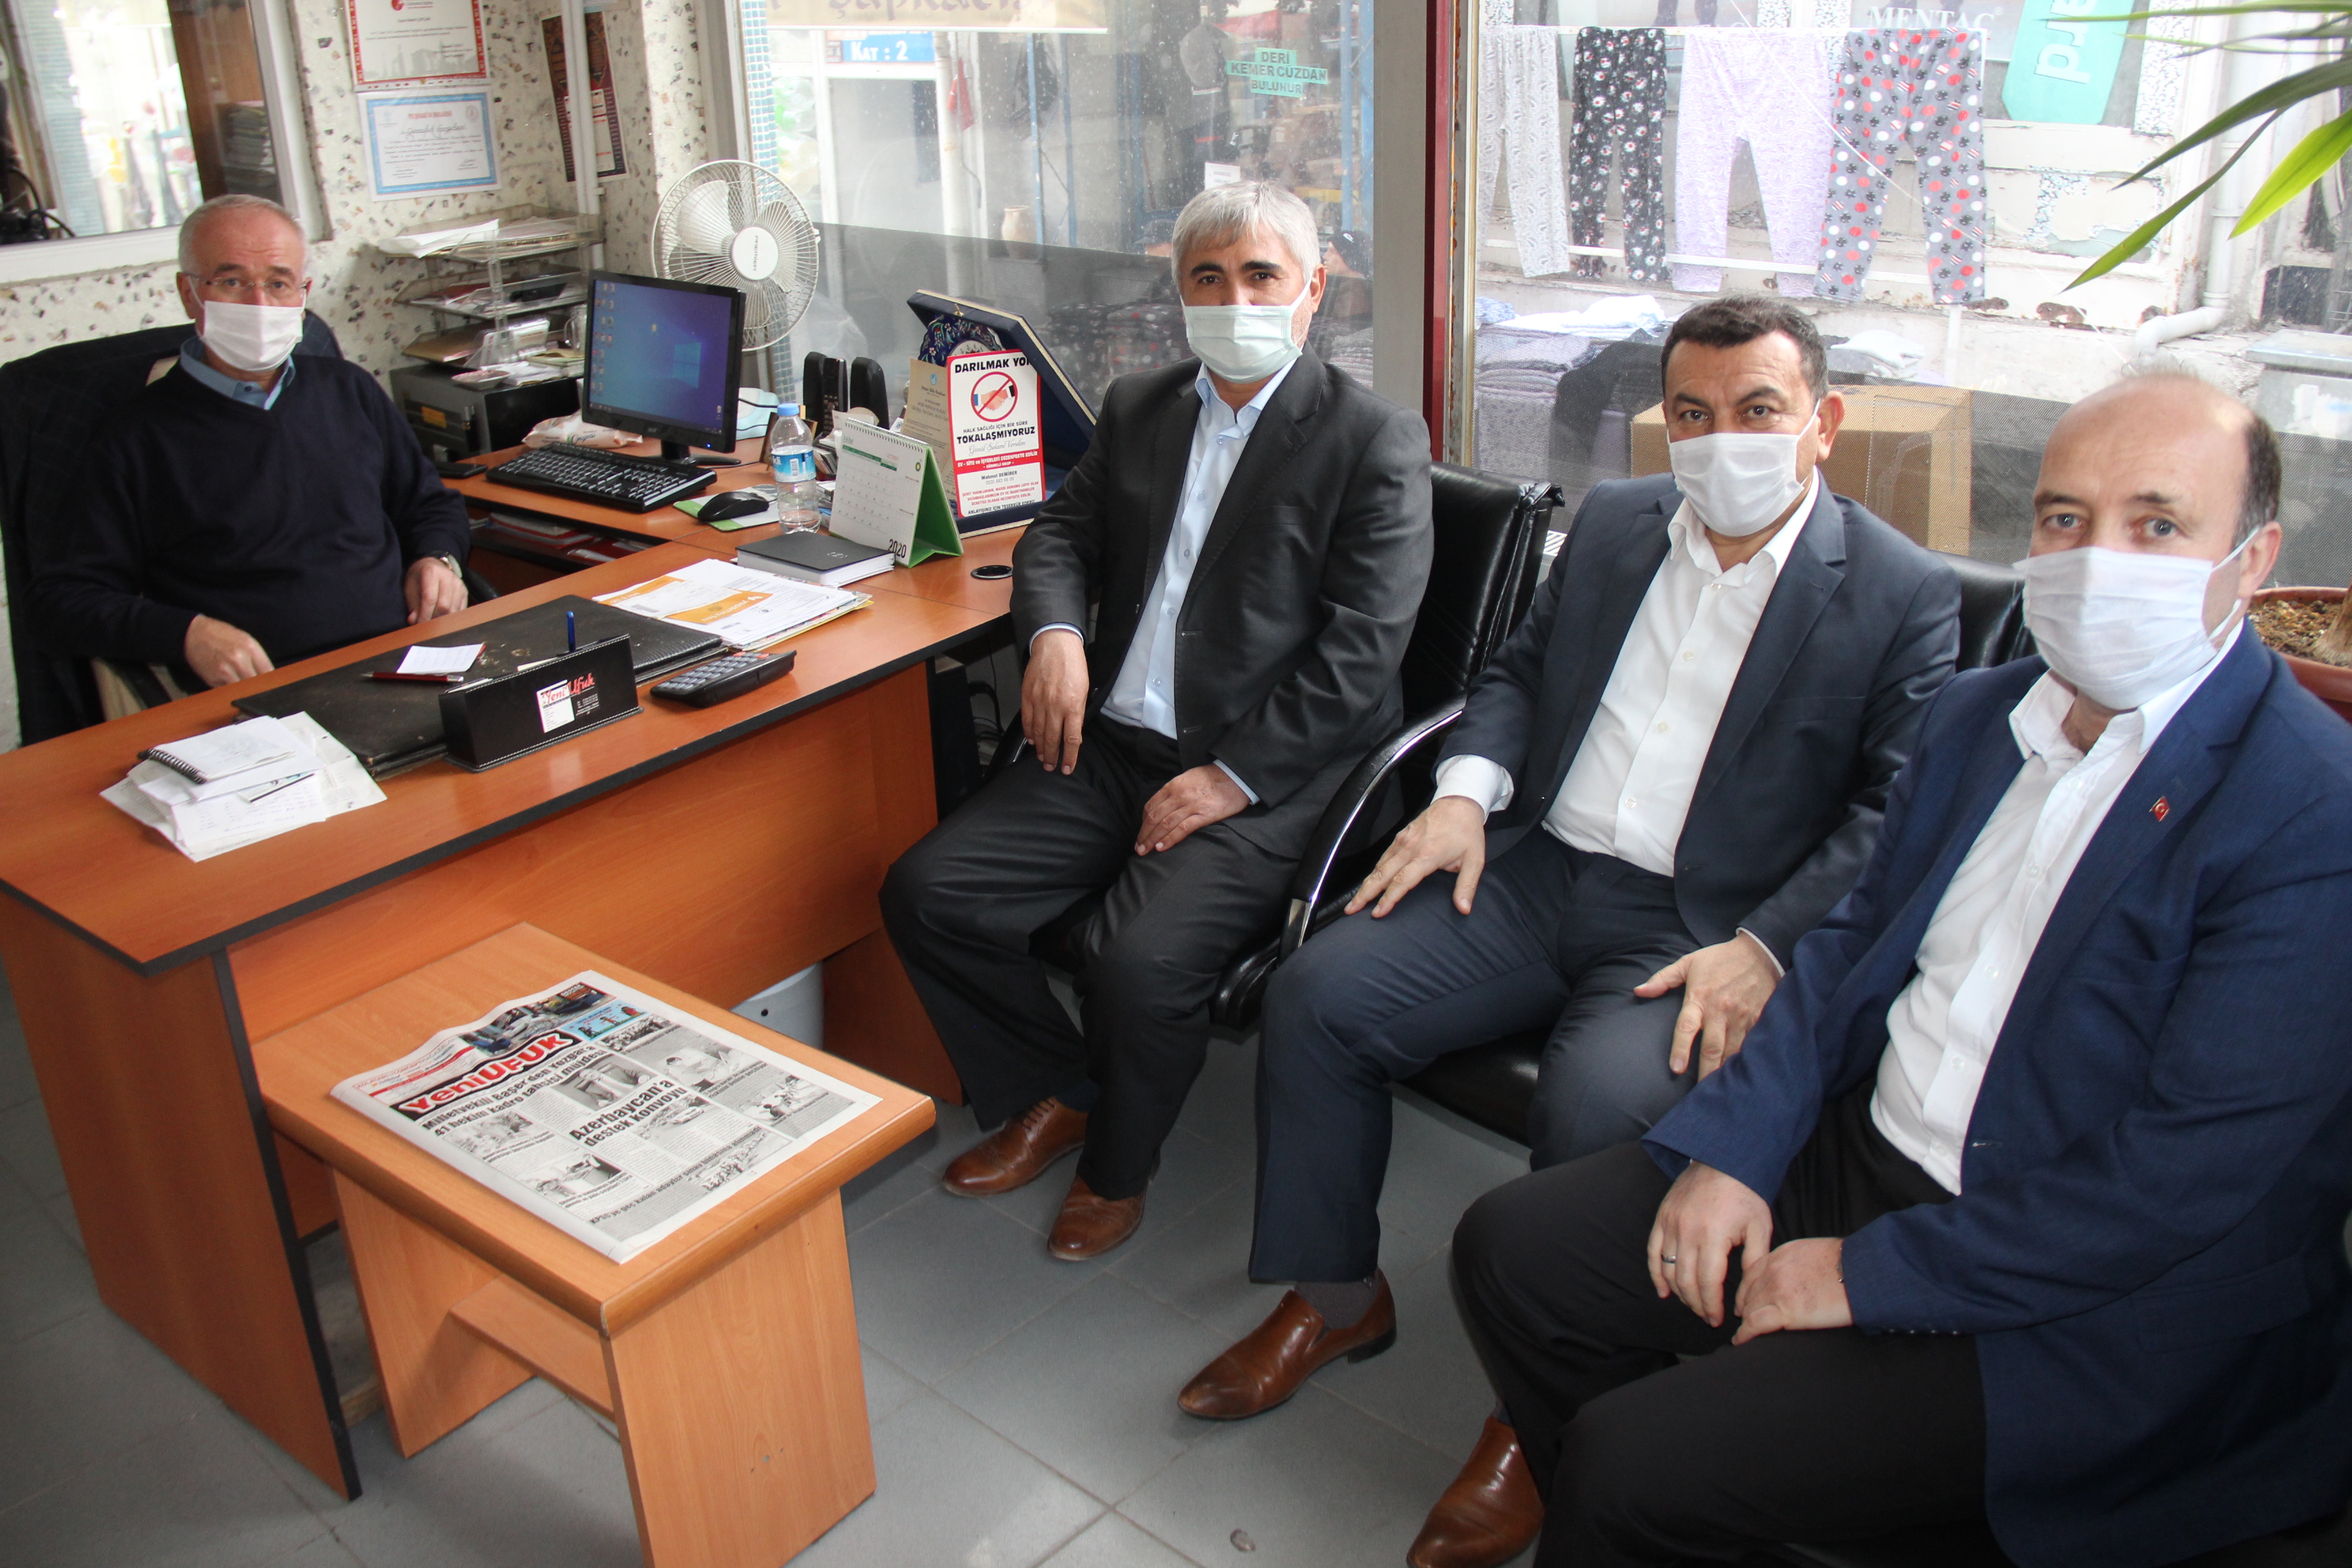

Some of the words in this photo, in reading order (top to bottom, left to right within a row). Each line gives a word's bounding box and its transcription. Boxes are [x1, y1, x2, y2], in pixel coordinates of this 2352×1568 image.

[896, 40, 909, 61] 2
[1261, 51, 1290, 64] DERİ
[1231, 63, 1274, 76] KEMER
[1277, 65, 1327, 81] CÜZDAN
[1252, 80, 1302, 93] BULUNUR
[955, 359, 1009, 373] DARILMAK
[957, 426, 1035, 444] TOKALAŞMIYORUZ
[981, 455, 1000, 464] İŞYERLERİ
[1001, 453, 1025, 461] DEZENFEKTE
[968, 507, 992, 515] ANLAYIŞINIZ
[542, 689, 567, 704] Yeni
[566, 672, 595, 695] Ufuk
[431, 1124, 453, 1137] 41
[446, 1109, 490, 1128] hekim
[485, 1094, 525, 1113] kadro
[519, 1073, 565, 1097] tahsisi
[557, 1048, 608, 1075] müjdesi
[421, 1096, 495, 1130] Milletvekili
[567, 1078, 677, 1140] Azerbaycan'a
[581, 1117, 634, 1147] destek
[627, 1086, 691, 1122] konvoyu
[632, 1189, 657, 1205] kalan
[653, 1173, 685, 1193] adaylar
[681, 1162, 704, 1176] sınav
[698, 1143, 734, 1164] binasına
[727, 1125, 763, 1146] alınmadı
